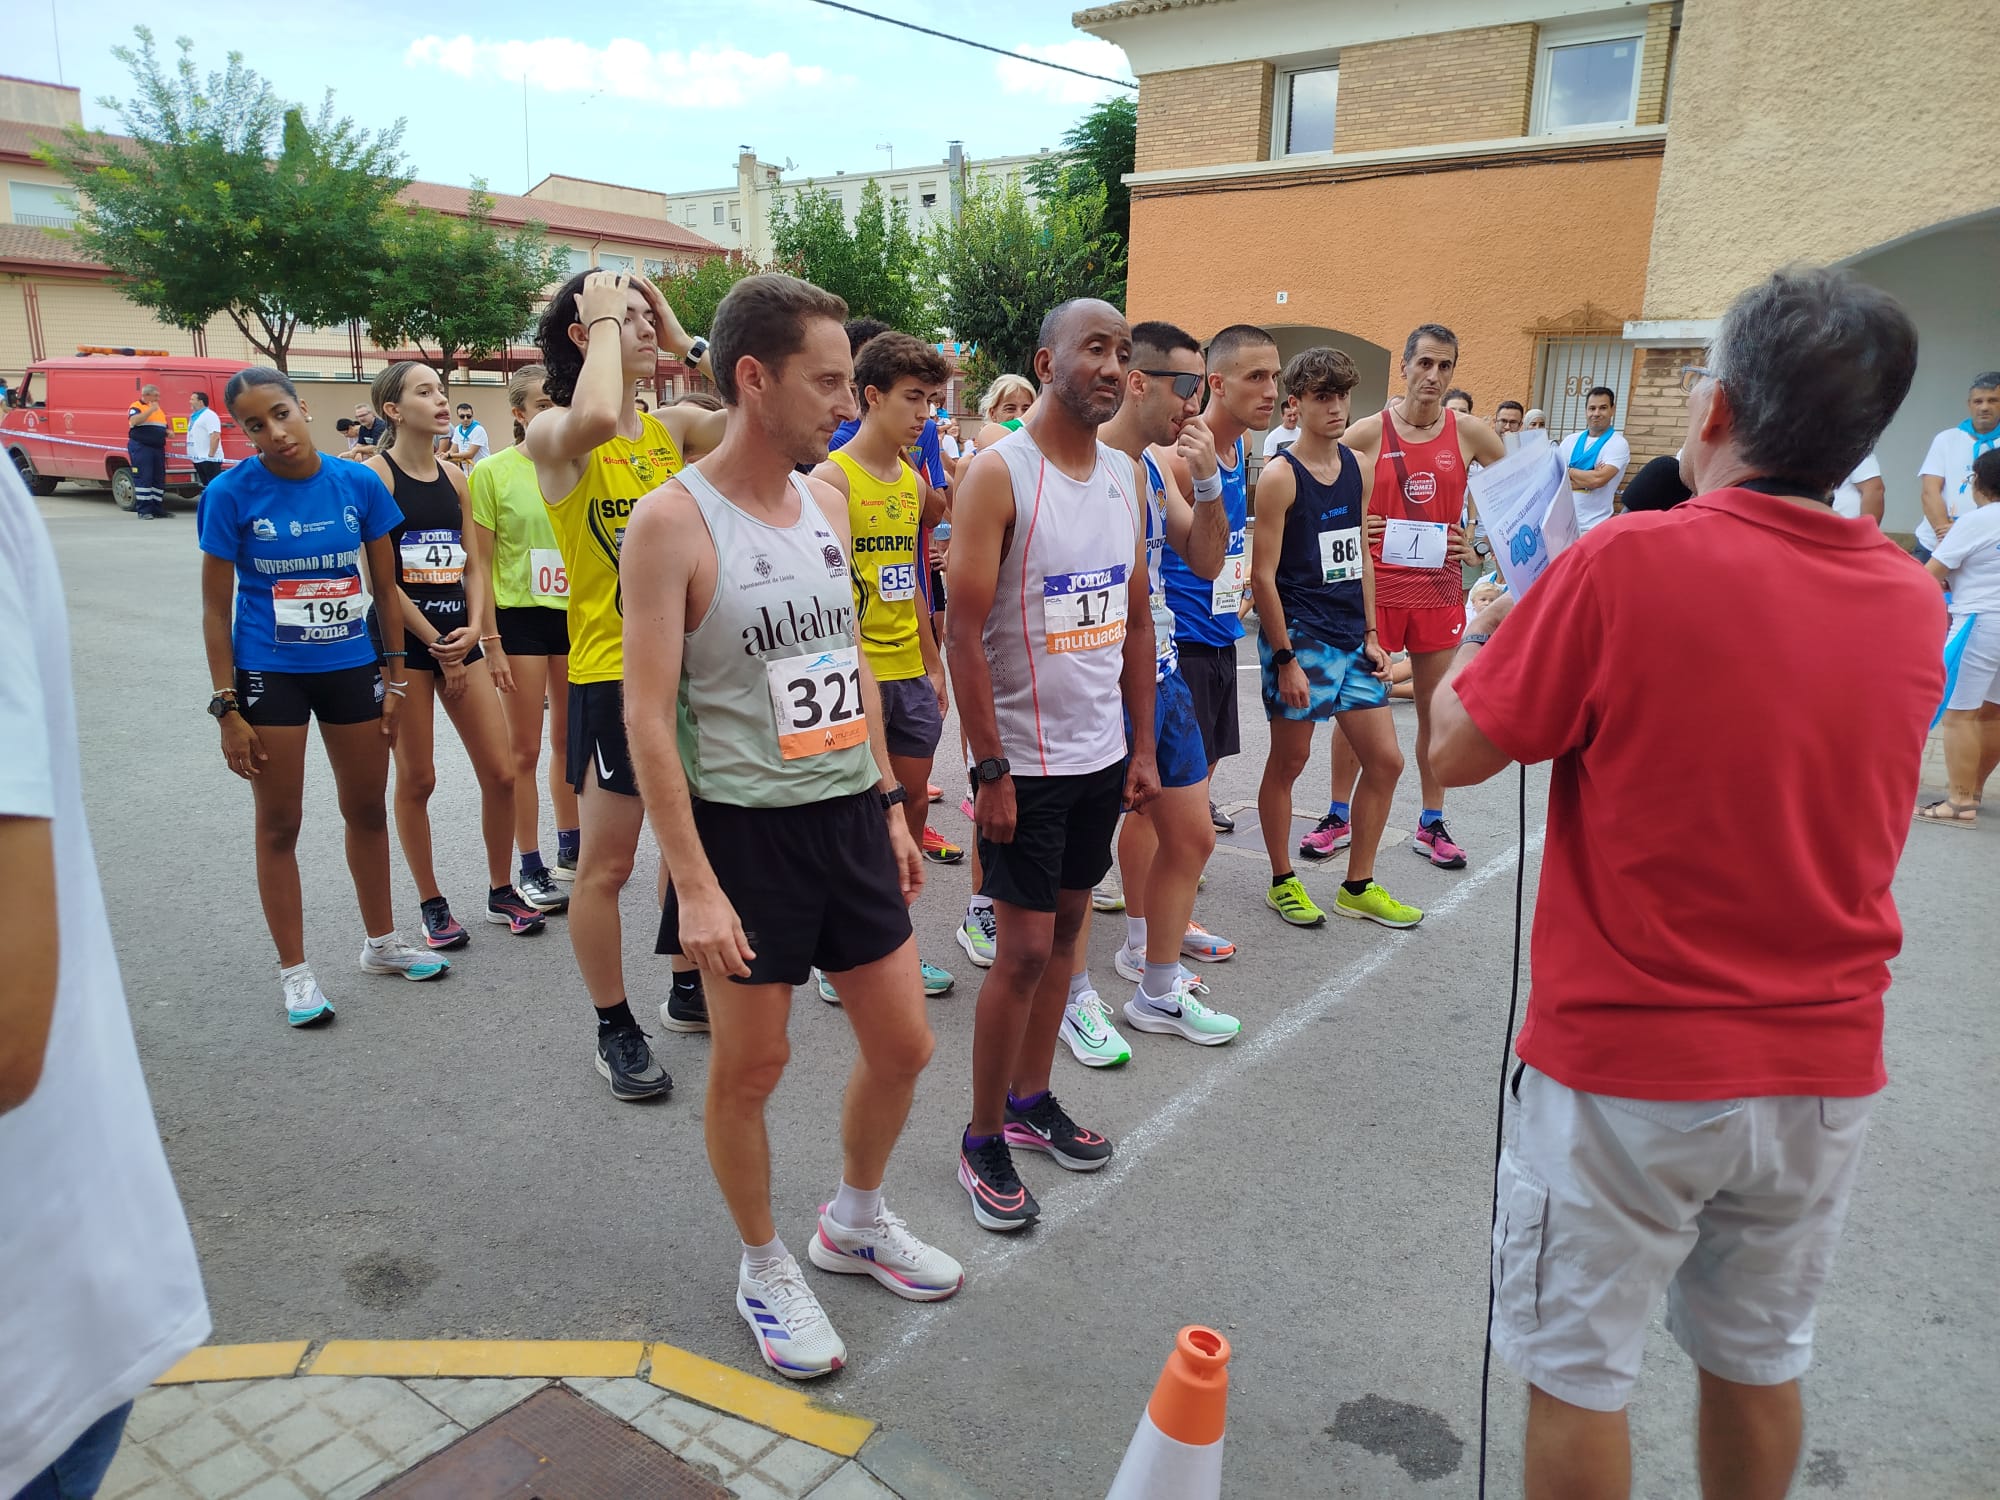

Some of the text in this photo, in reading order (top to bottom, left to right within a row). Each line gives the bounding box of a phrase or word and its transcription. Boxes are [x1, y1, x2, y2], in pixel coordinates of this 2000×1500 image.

[425, 545, 453, 568] 47
[1406, 533, 1425, 560] 1
[1511, 524, 1537, 567] 40
[253, 556, 319, 575] UNIVERSIDAD
[322, 554, 335, 569] DE
[539, 566, 568, 594] 05
[303, 600, 349, 623] 196
[1076, 590, 1110, 627] 17
[787, 668, 865, 729] 321
